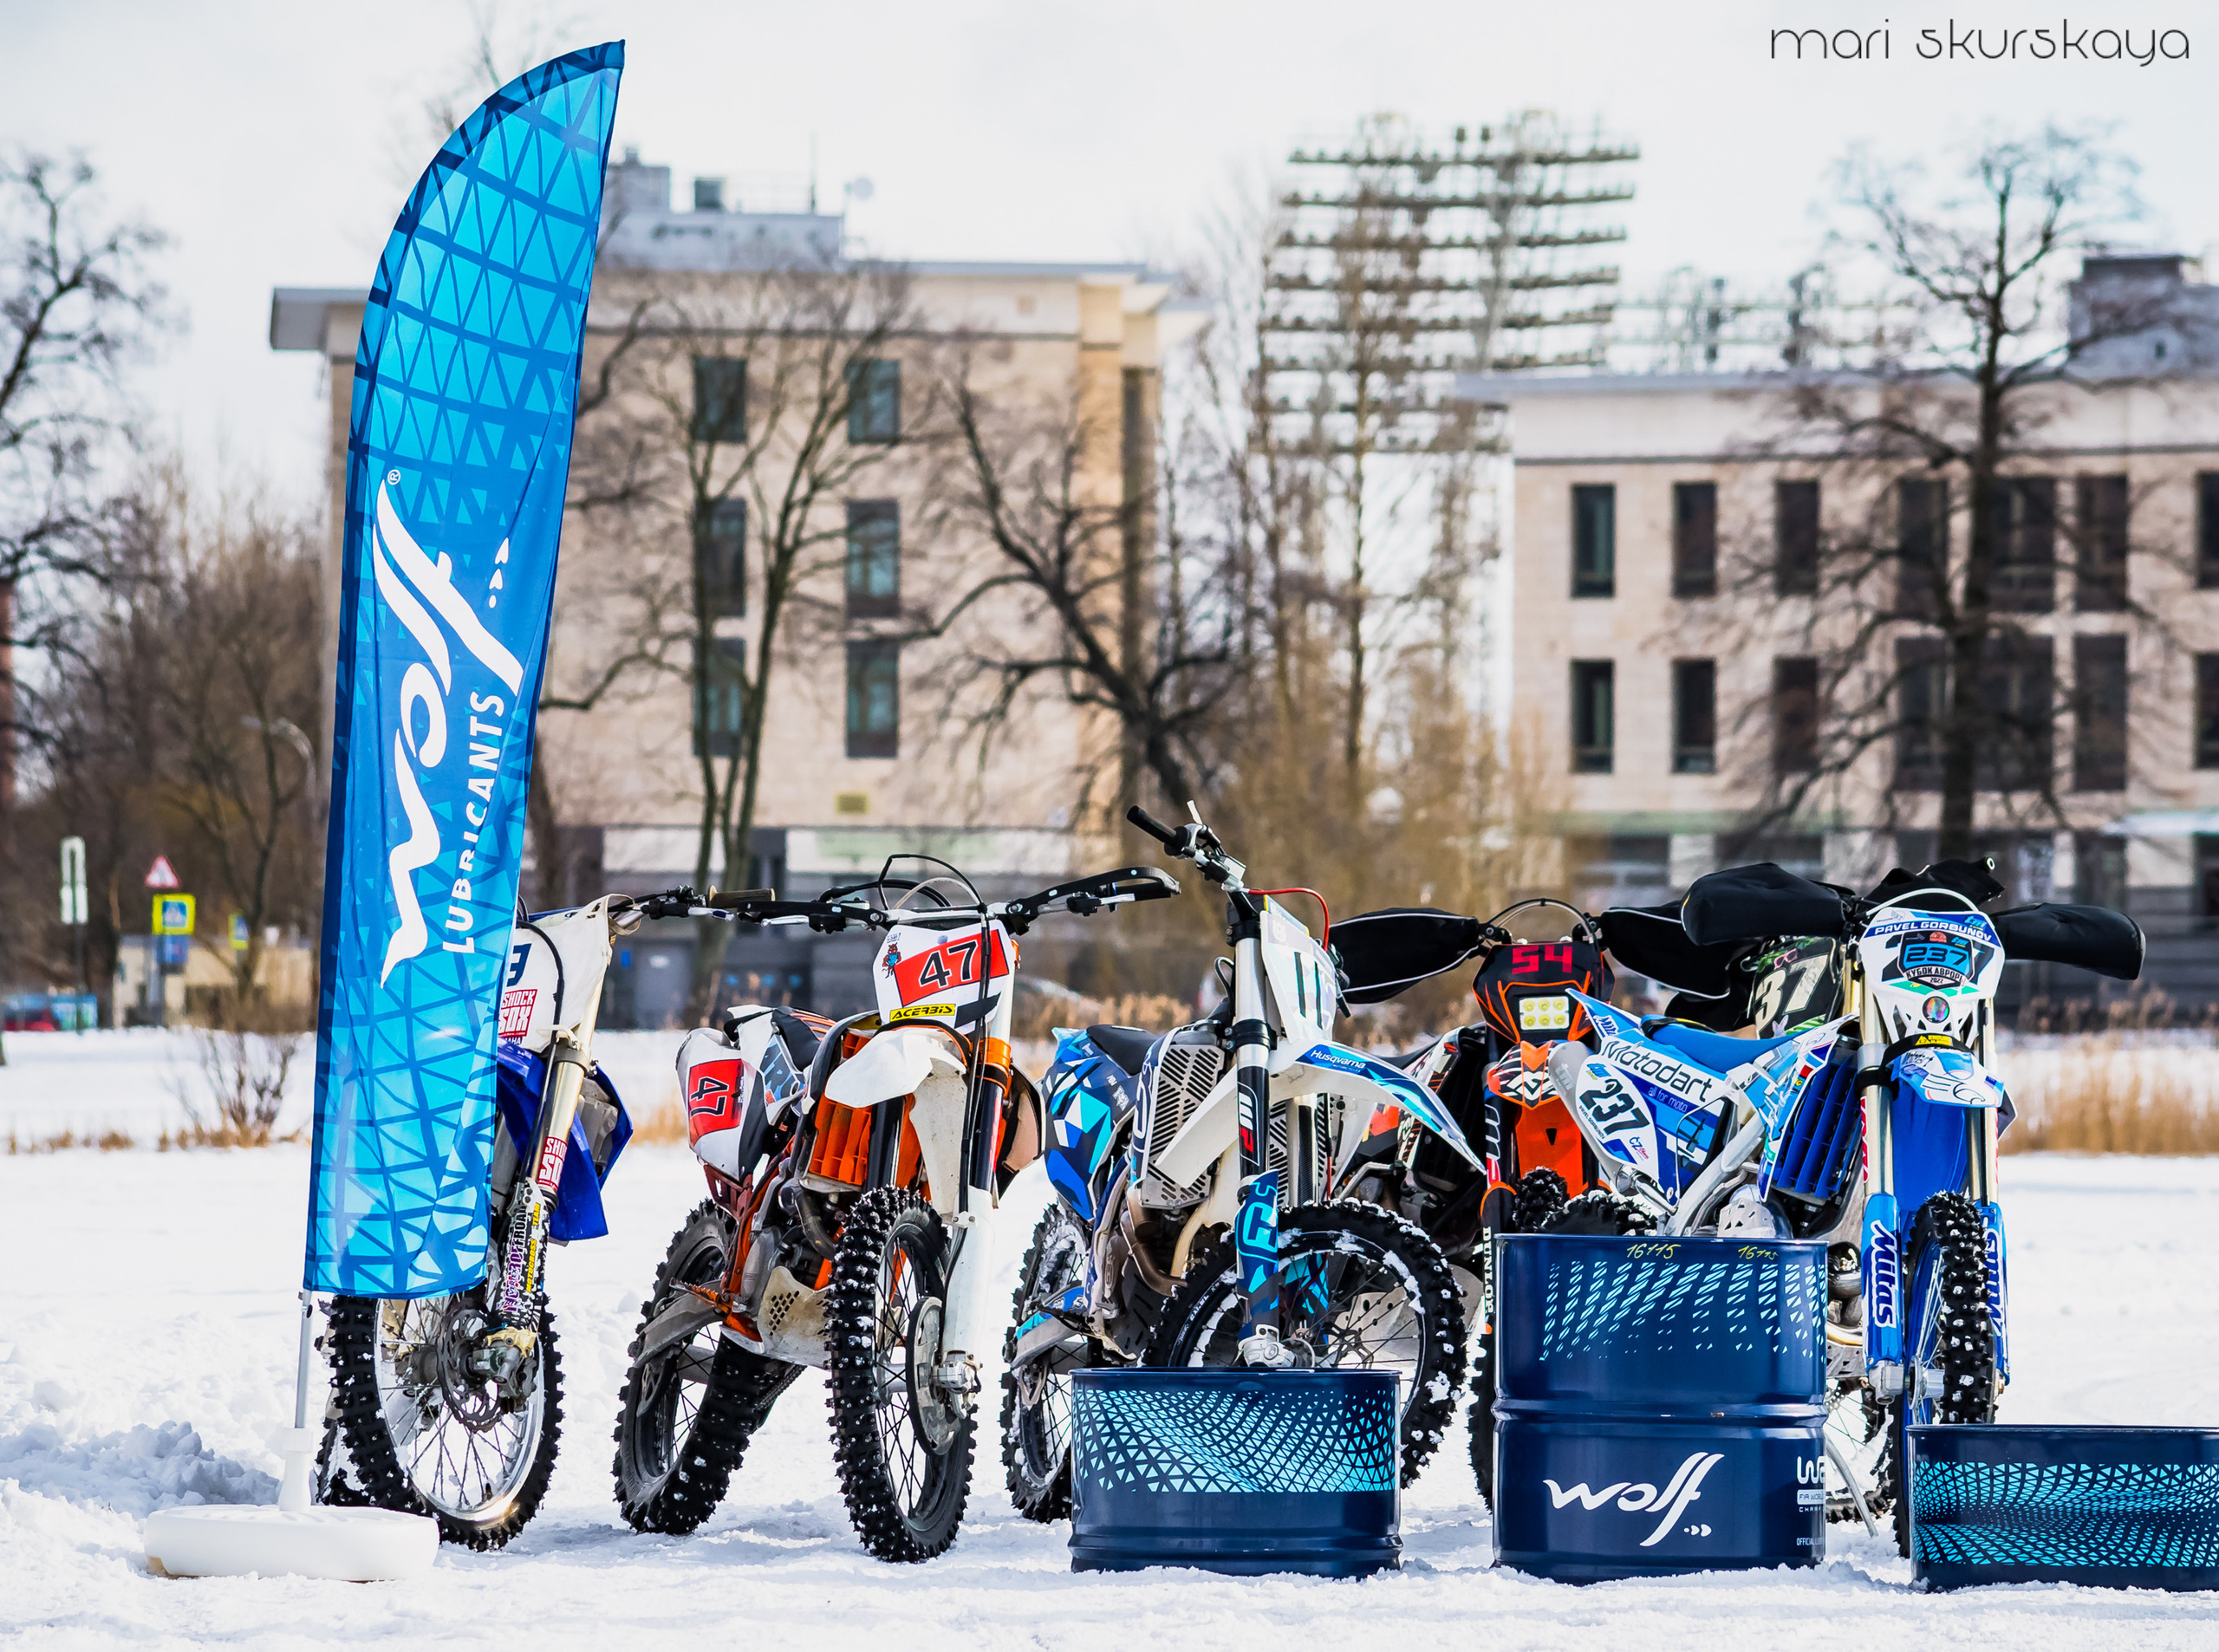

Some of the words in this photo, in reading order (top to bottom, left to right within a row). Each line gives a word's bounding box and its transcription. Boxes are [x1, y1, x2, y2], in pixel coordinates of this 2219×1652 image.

[442, 690, 504, 954] LUBRICANTS
[1874, 922, 1918, 934] PAVEL
[1920, 921, 1992, 941] GORBUNOV
[918, 940, 979, 988] 47
[1512, 944, 1573, 974] 54
[1906, 946, 1968, 966] 237
[1906, 967, 1933, 979] КУБОК
[503, 990, 536, 1008] SHOCK
[498, 1005, 531, 1034] SOX
[1310, 1049, 1367, 1069] Husqvarna
[1601, 1041, 1713, 1102] Motodart
[689, 1076, 730, 1119] 47
[1579, 1079, 1650, 1135] 237
[1648, 1086, 1658, 1097] all
[1656, 1089, 1669, 1102] for
[1668, 1097, 1688, 1113] moto
[526, 1238, 537, 1293] MOTOCROSS
[532, 1202, 541, 1226] TEAM
[1627, 1243, 1682, 1259] 16115
[1482, 1226, 1494, 1313] DUNLOP
[1871, 1219, 1897, 1329] Mitas
[1542, 1452, 1725, 1547] wolf
